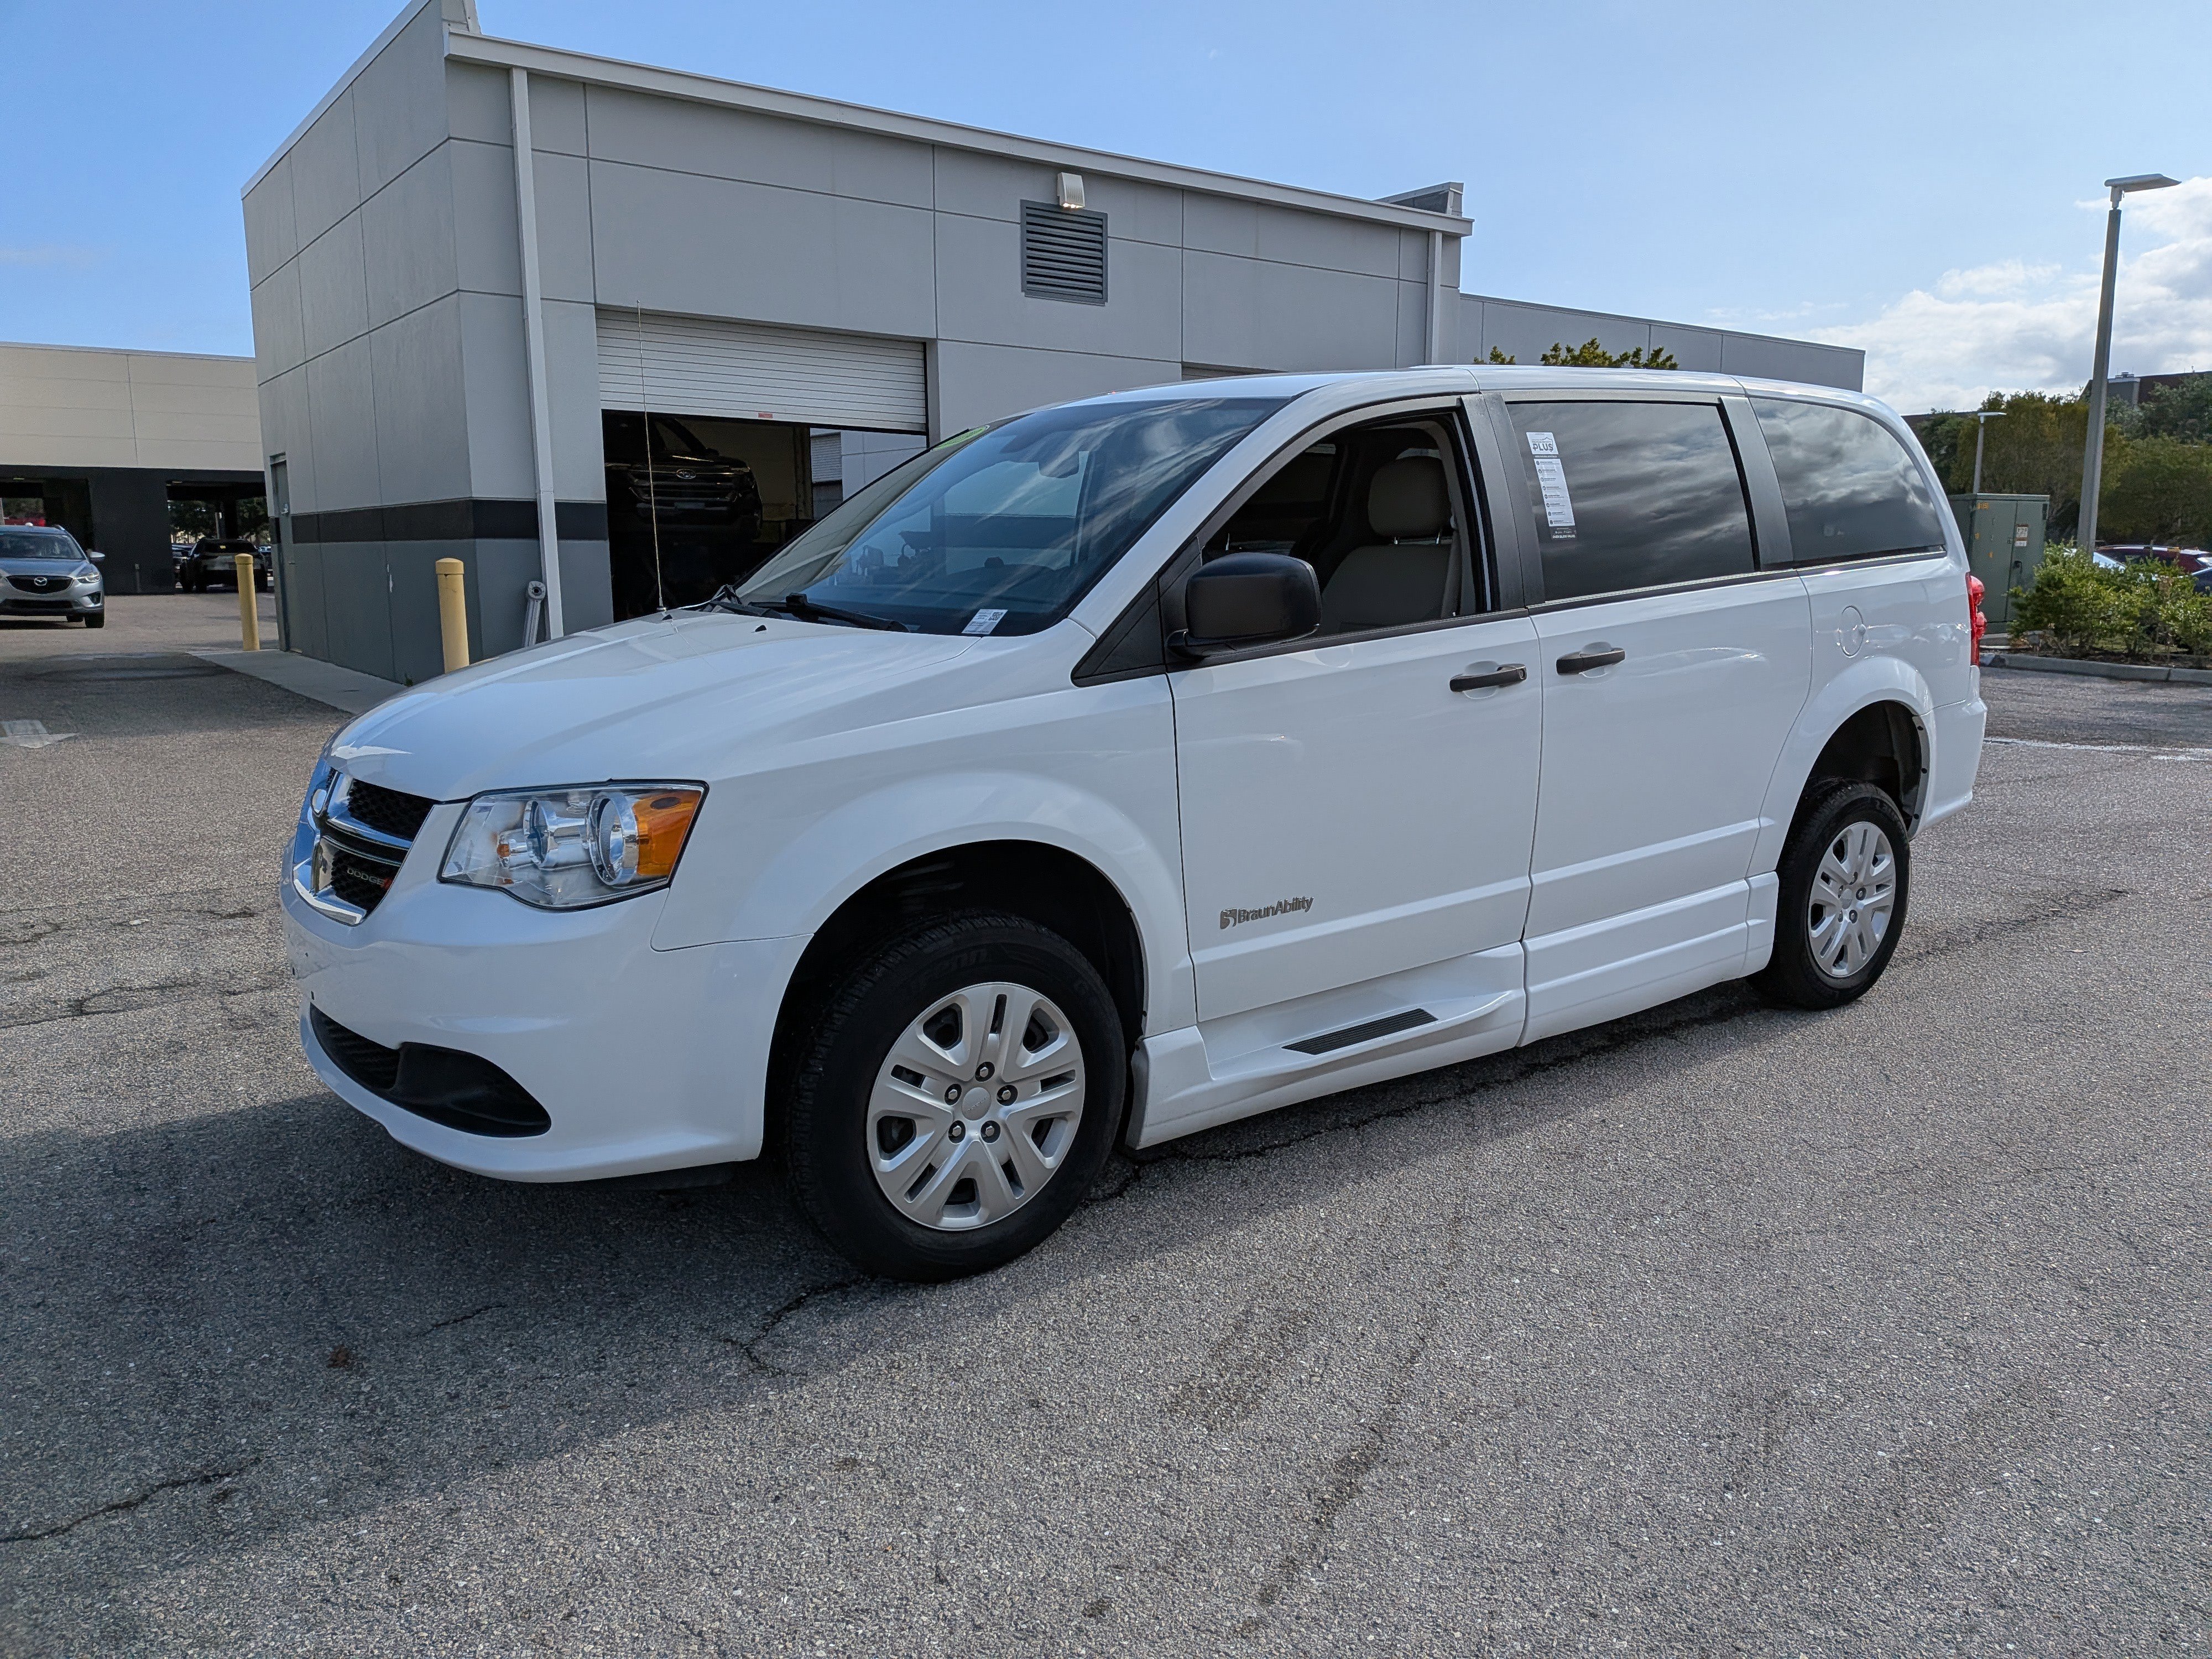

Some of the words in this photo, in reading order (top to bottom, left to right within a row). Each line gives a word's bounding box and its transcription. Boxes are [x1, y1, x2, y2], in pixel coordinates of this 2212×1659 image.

[1532, 443, 1553, 451] PLUS
[347, 865, 385, 886] DODGE
[1238, 896, 1314, 924] BraunAbility
